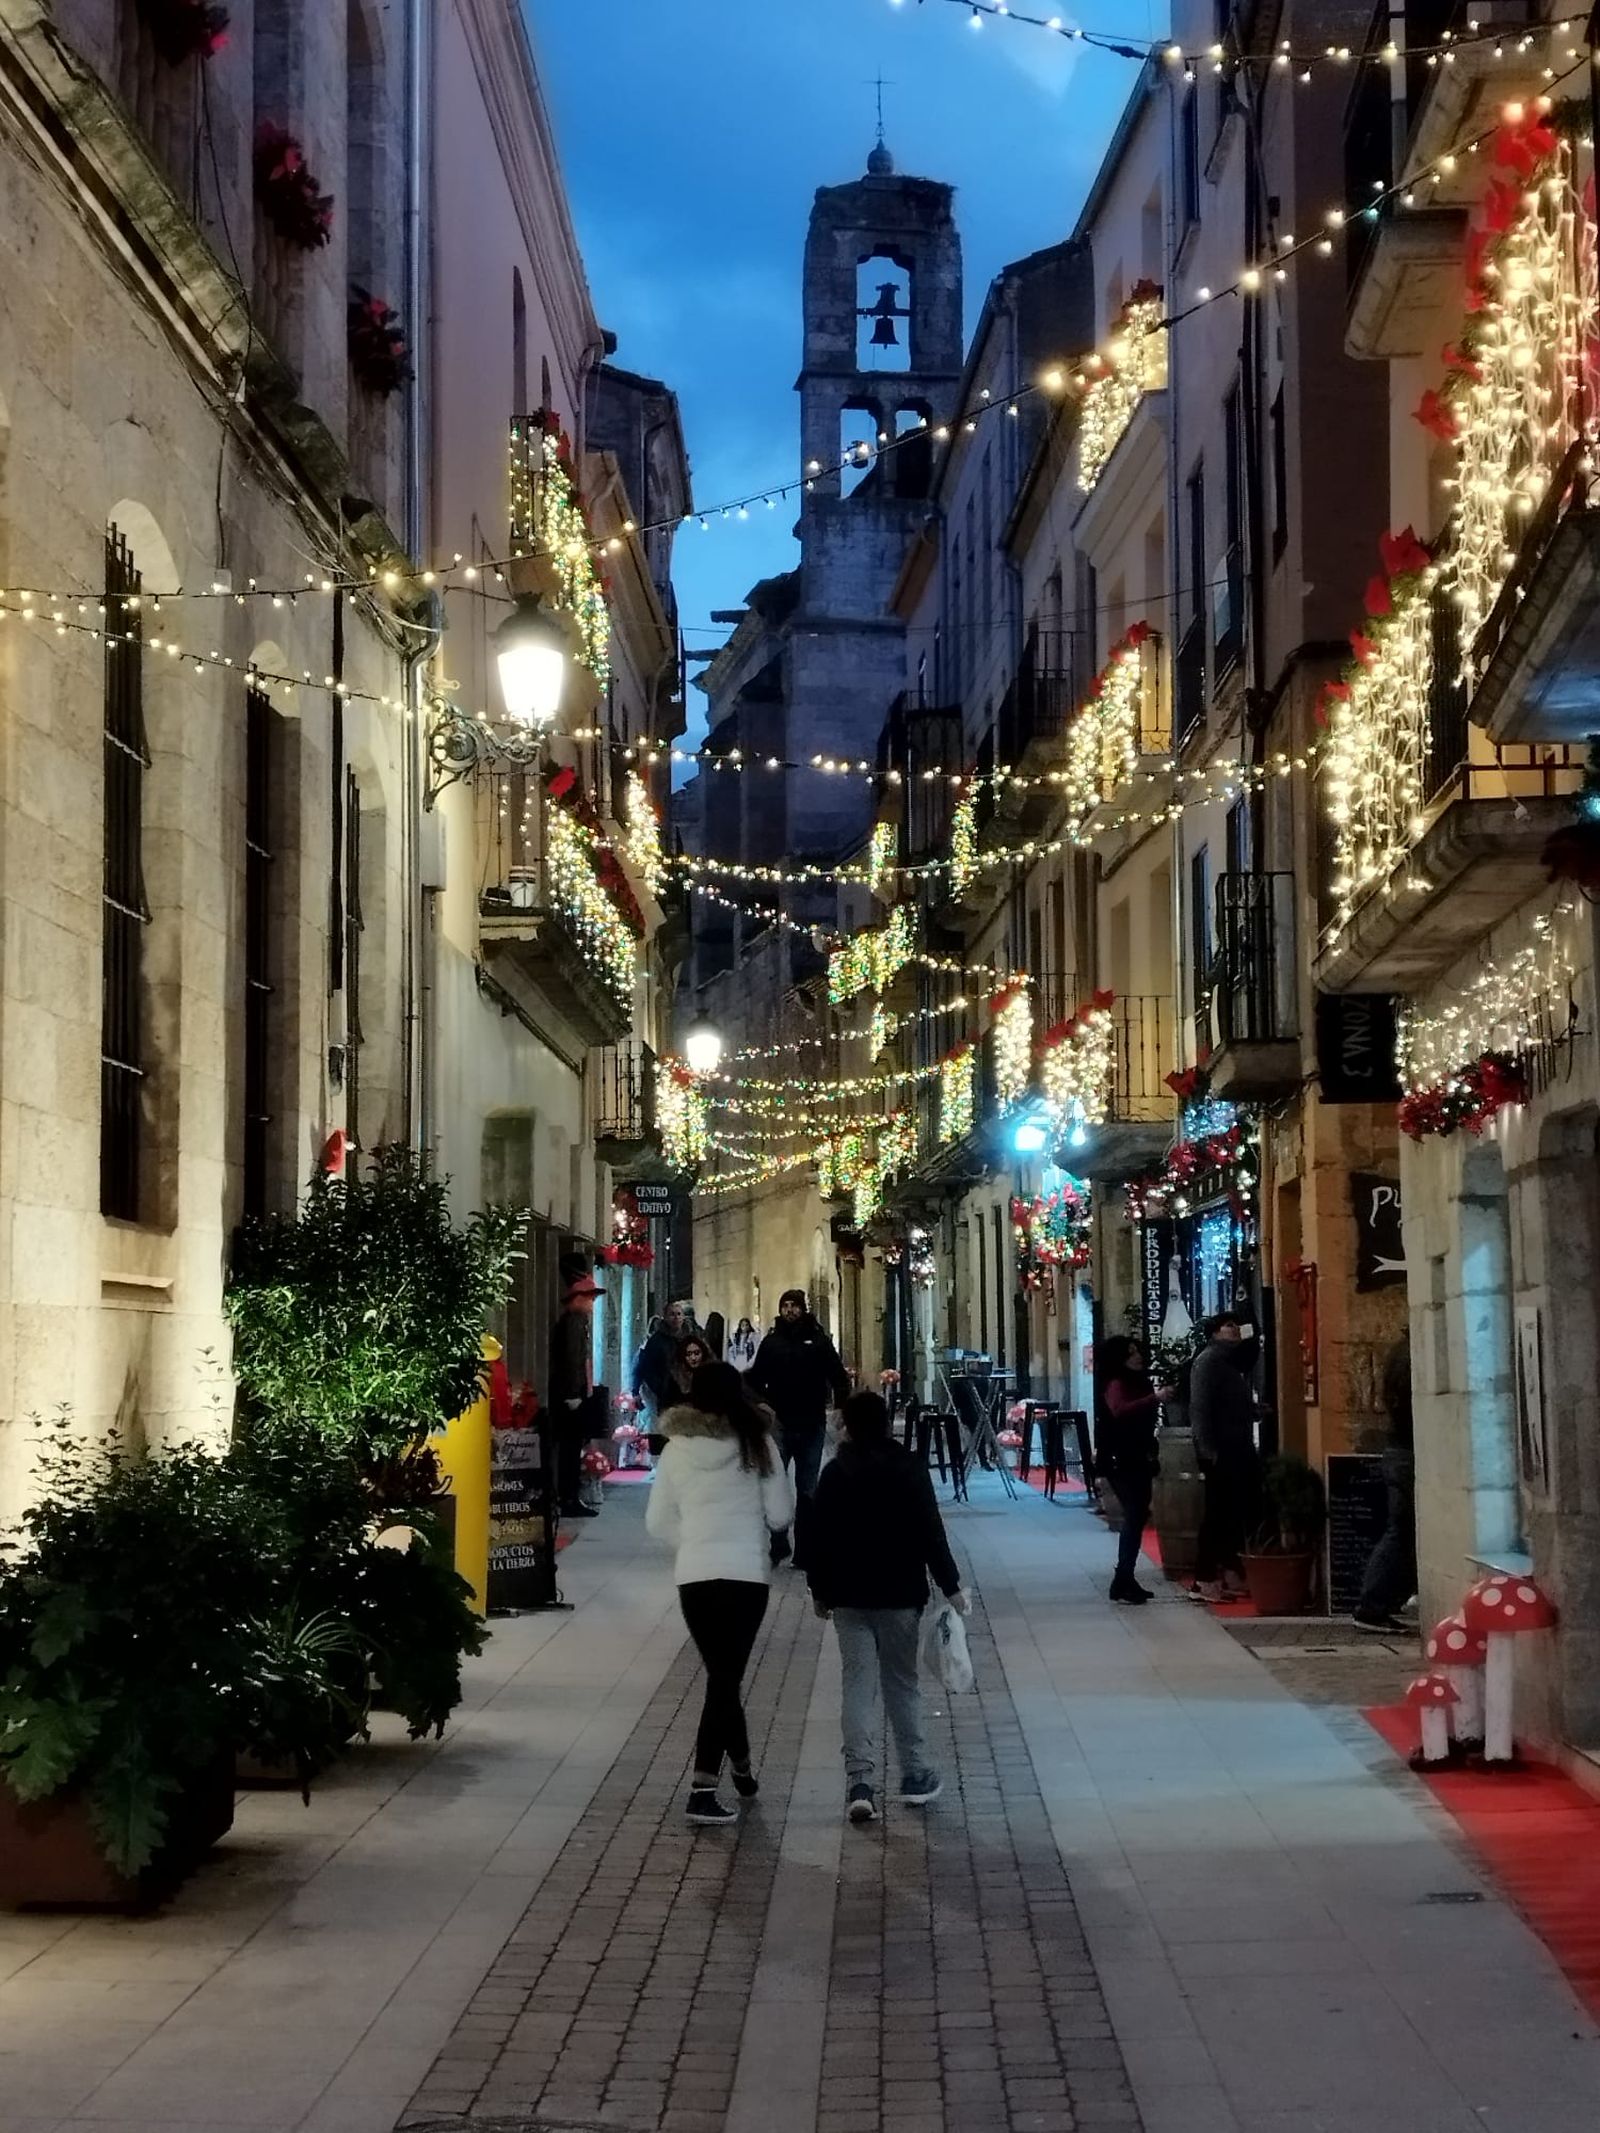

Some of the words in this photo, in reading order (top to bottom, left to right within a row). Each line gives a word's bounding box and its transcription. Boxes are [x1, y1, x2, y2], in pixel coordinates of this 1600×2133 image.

[635, 1186, 669, 1198] CENTRO
[637, 1201, 672, 1214] UDITIVO
[1145, 1227, 1161, 1320] PRODUCTOS
[1149, 1324, 1161, 1345] DE
